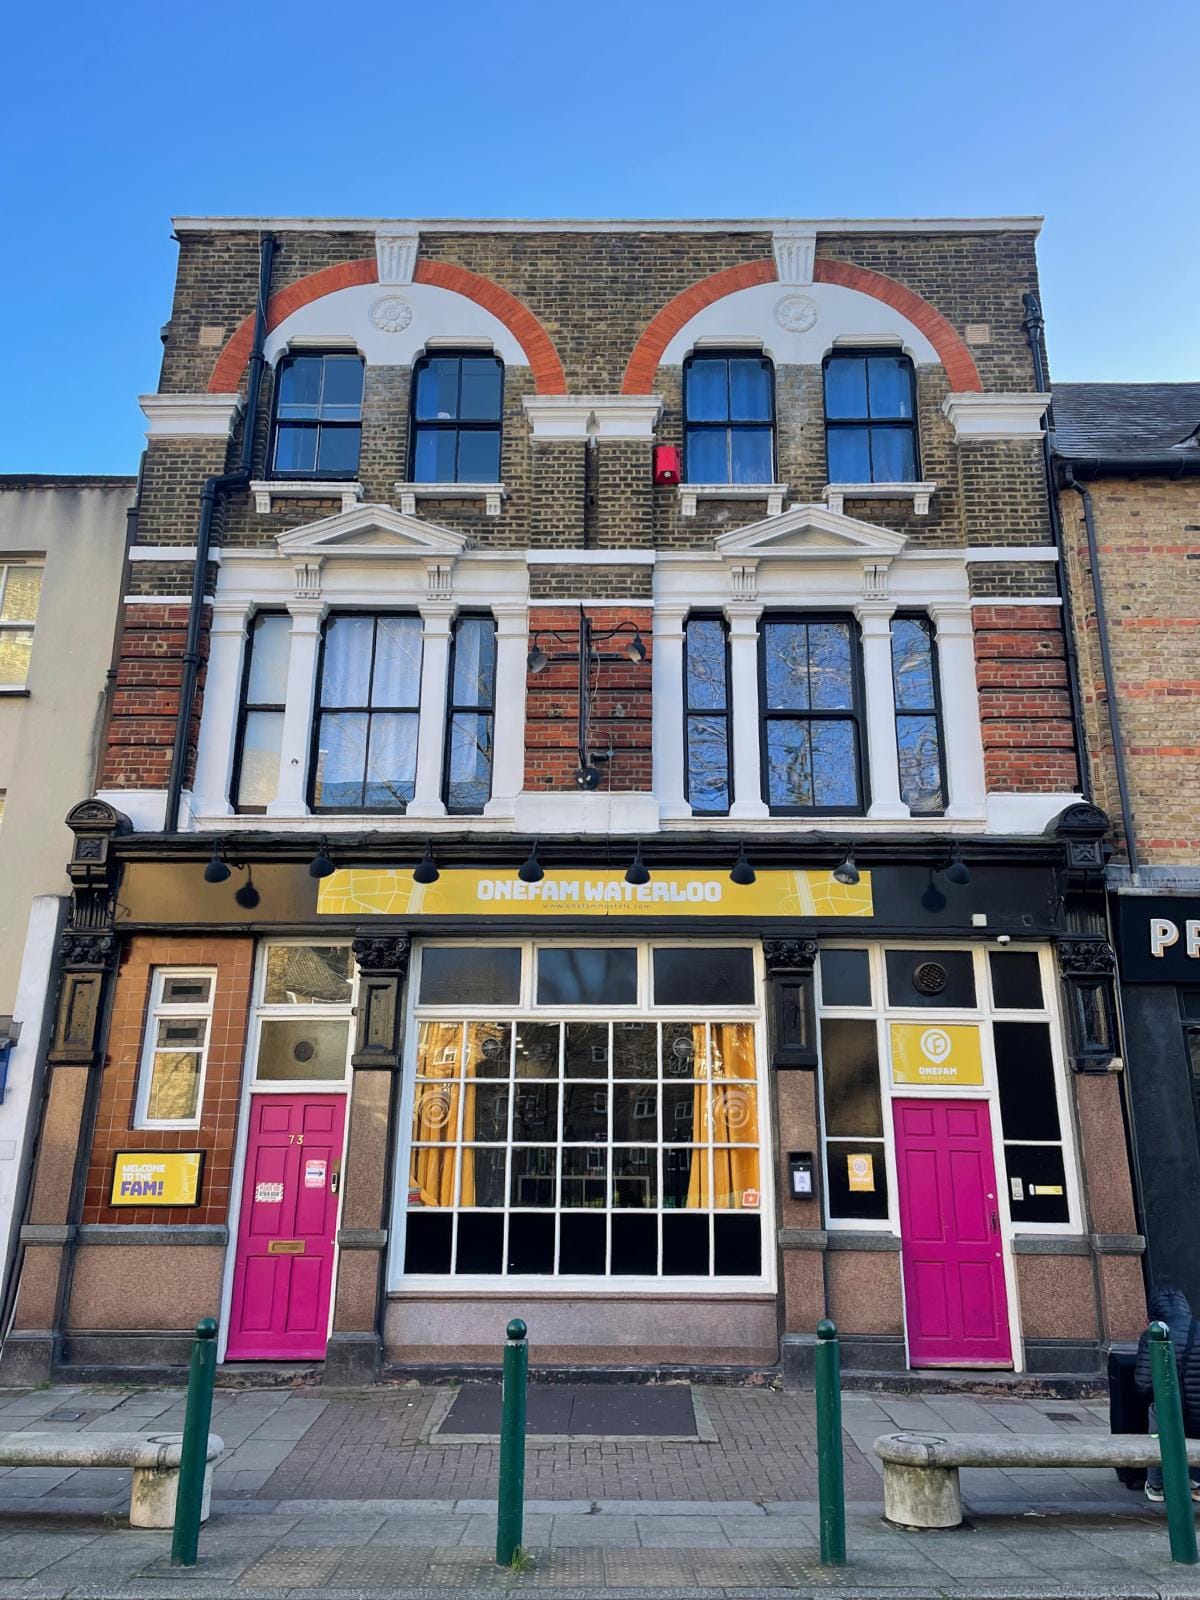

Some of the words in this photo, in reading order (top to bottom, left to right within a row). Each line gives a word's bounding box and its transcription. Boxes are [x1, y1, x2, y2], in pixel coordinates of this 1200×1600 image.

[477, 880, 579, 901] ONEFAM
[583, 880, 722, 902] WATERLOO
[918, 1066, 957, 1075] ONEFAM
[289, 1134, 304, 1145] 73
[122, 1164, 166, 1173] WELCOME
[122, 1172, 134, 1180] TO
[135, 1172, 152, 1180] THE
[120, 1181, 164, 1196] FAM!
